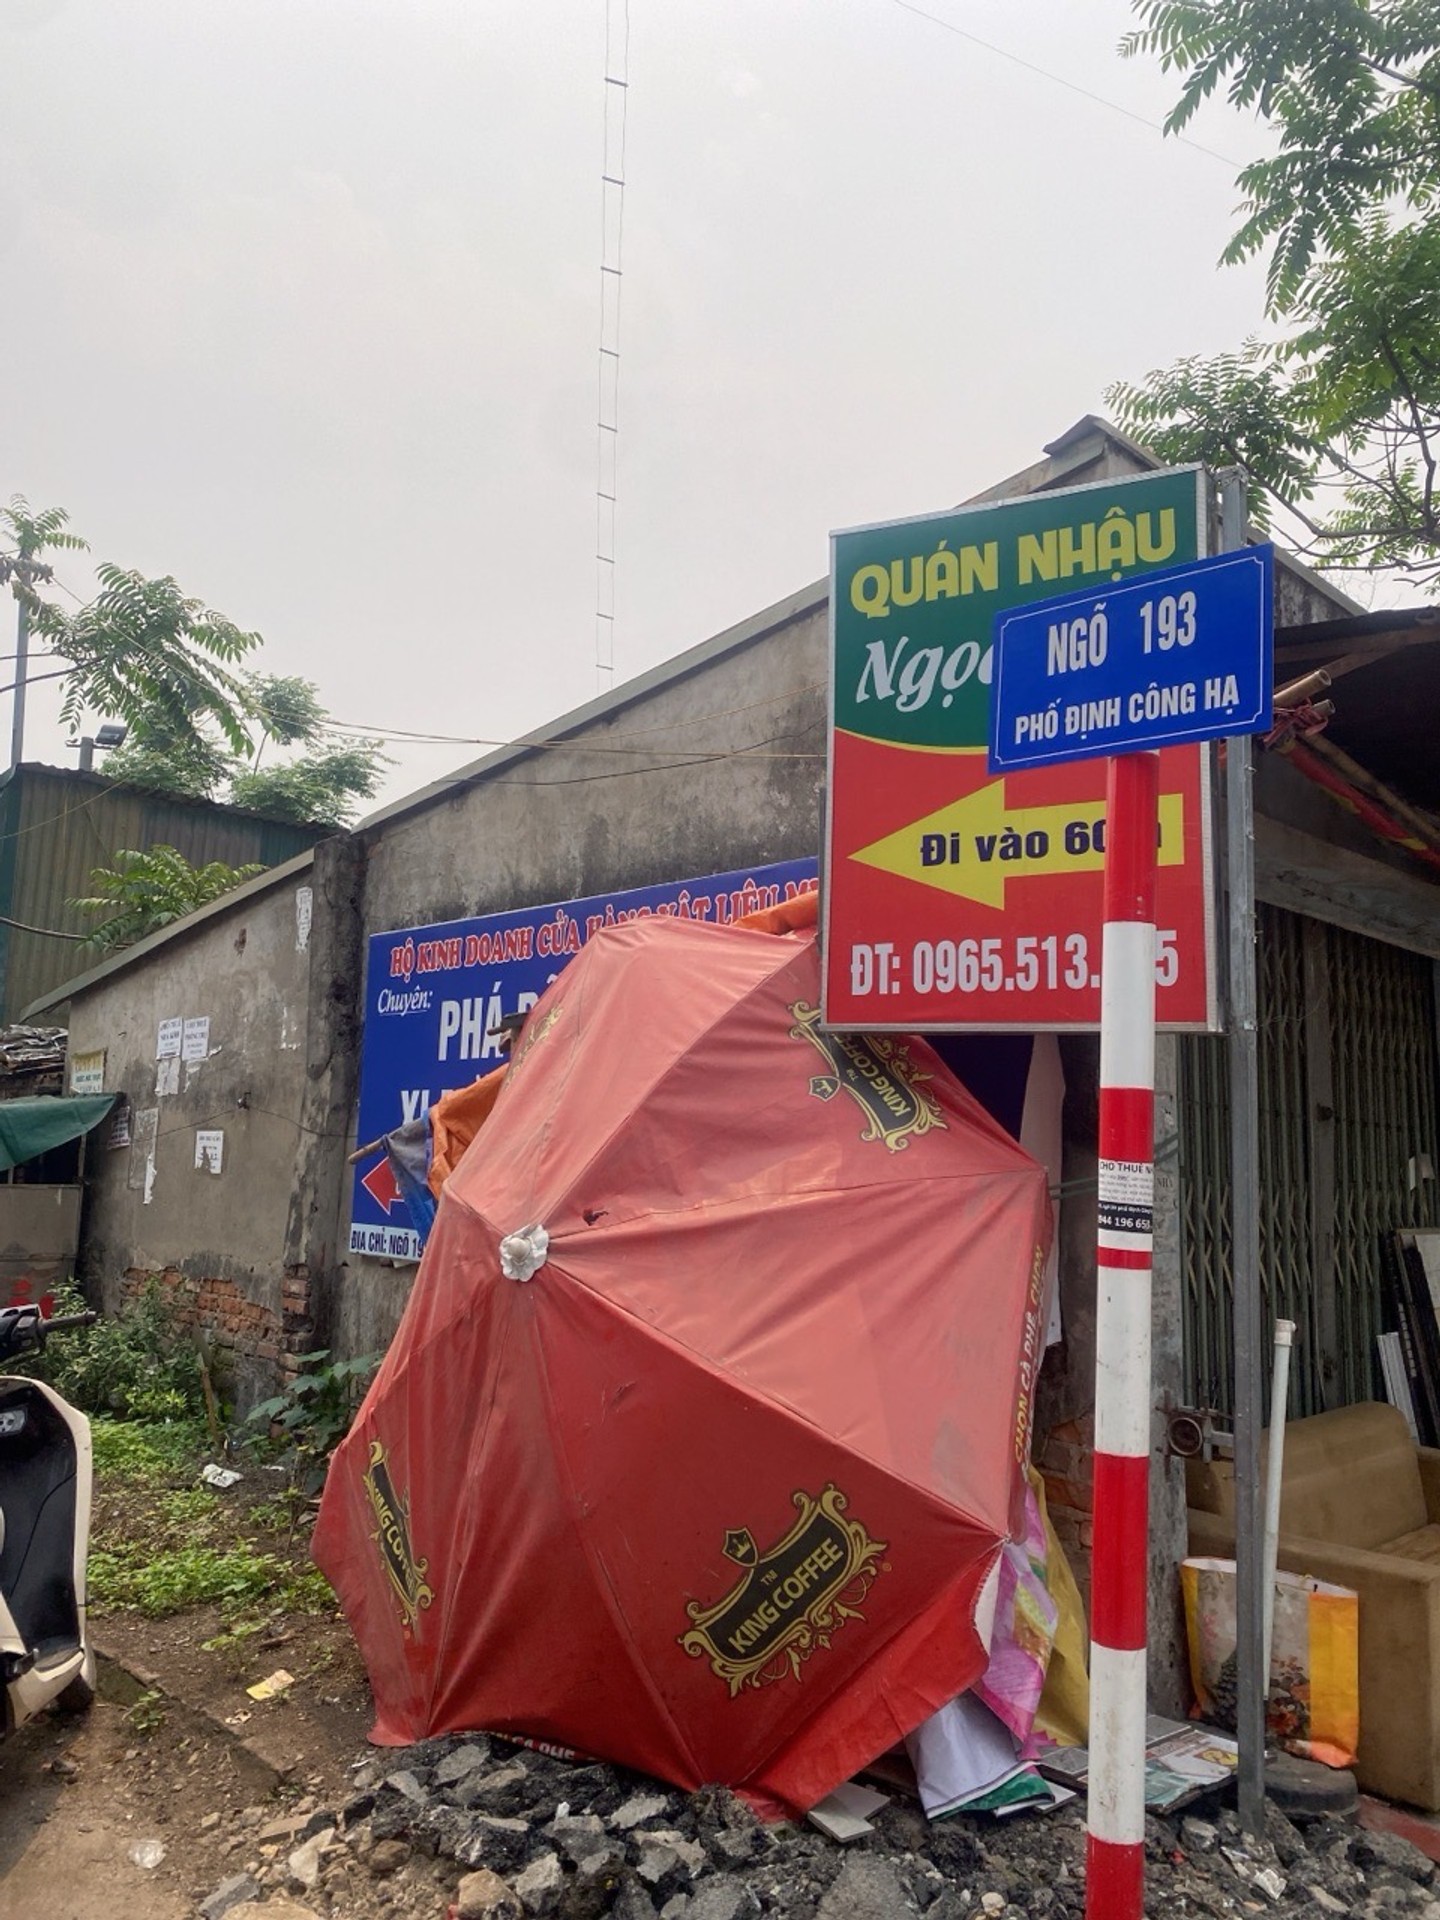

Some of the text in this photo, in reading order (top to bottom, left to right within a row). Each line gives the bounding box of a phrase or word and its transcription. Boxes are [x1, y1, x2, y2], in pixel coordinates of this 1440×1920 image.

[851, 506, 1176, 619] QUÁN NHẬU
[1047, 591, 1197, 676] NGÕ 193
[1014, 675, 1240, 745] PHỐ ĐỊNH CÔNG HẠ
[920, 832, 960, 867] Đi
[975, 826, 1049, 862] vào
[389, 935, 416, 983] HỘ
[416, 937, 463, 974] KINH
[464, 925, 534, 967] DOANH
[536, 908, 582, 958] CỬA
[851, 930, 1179, 996] ĐT: 0965.513.5
[377, 984, 434, 1016] Chuyên:
[438, 981, 504, 1061] PHÁ
[870, 1079, 912, 1117] KING
[728, 1537, 844, 1654] KING COFFEE
